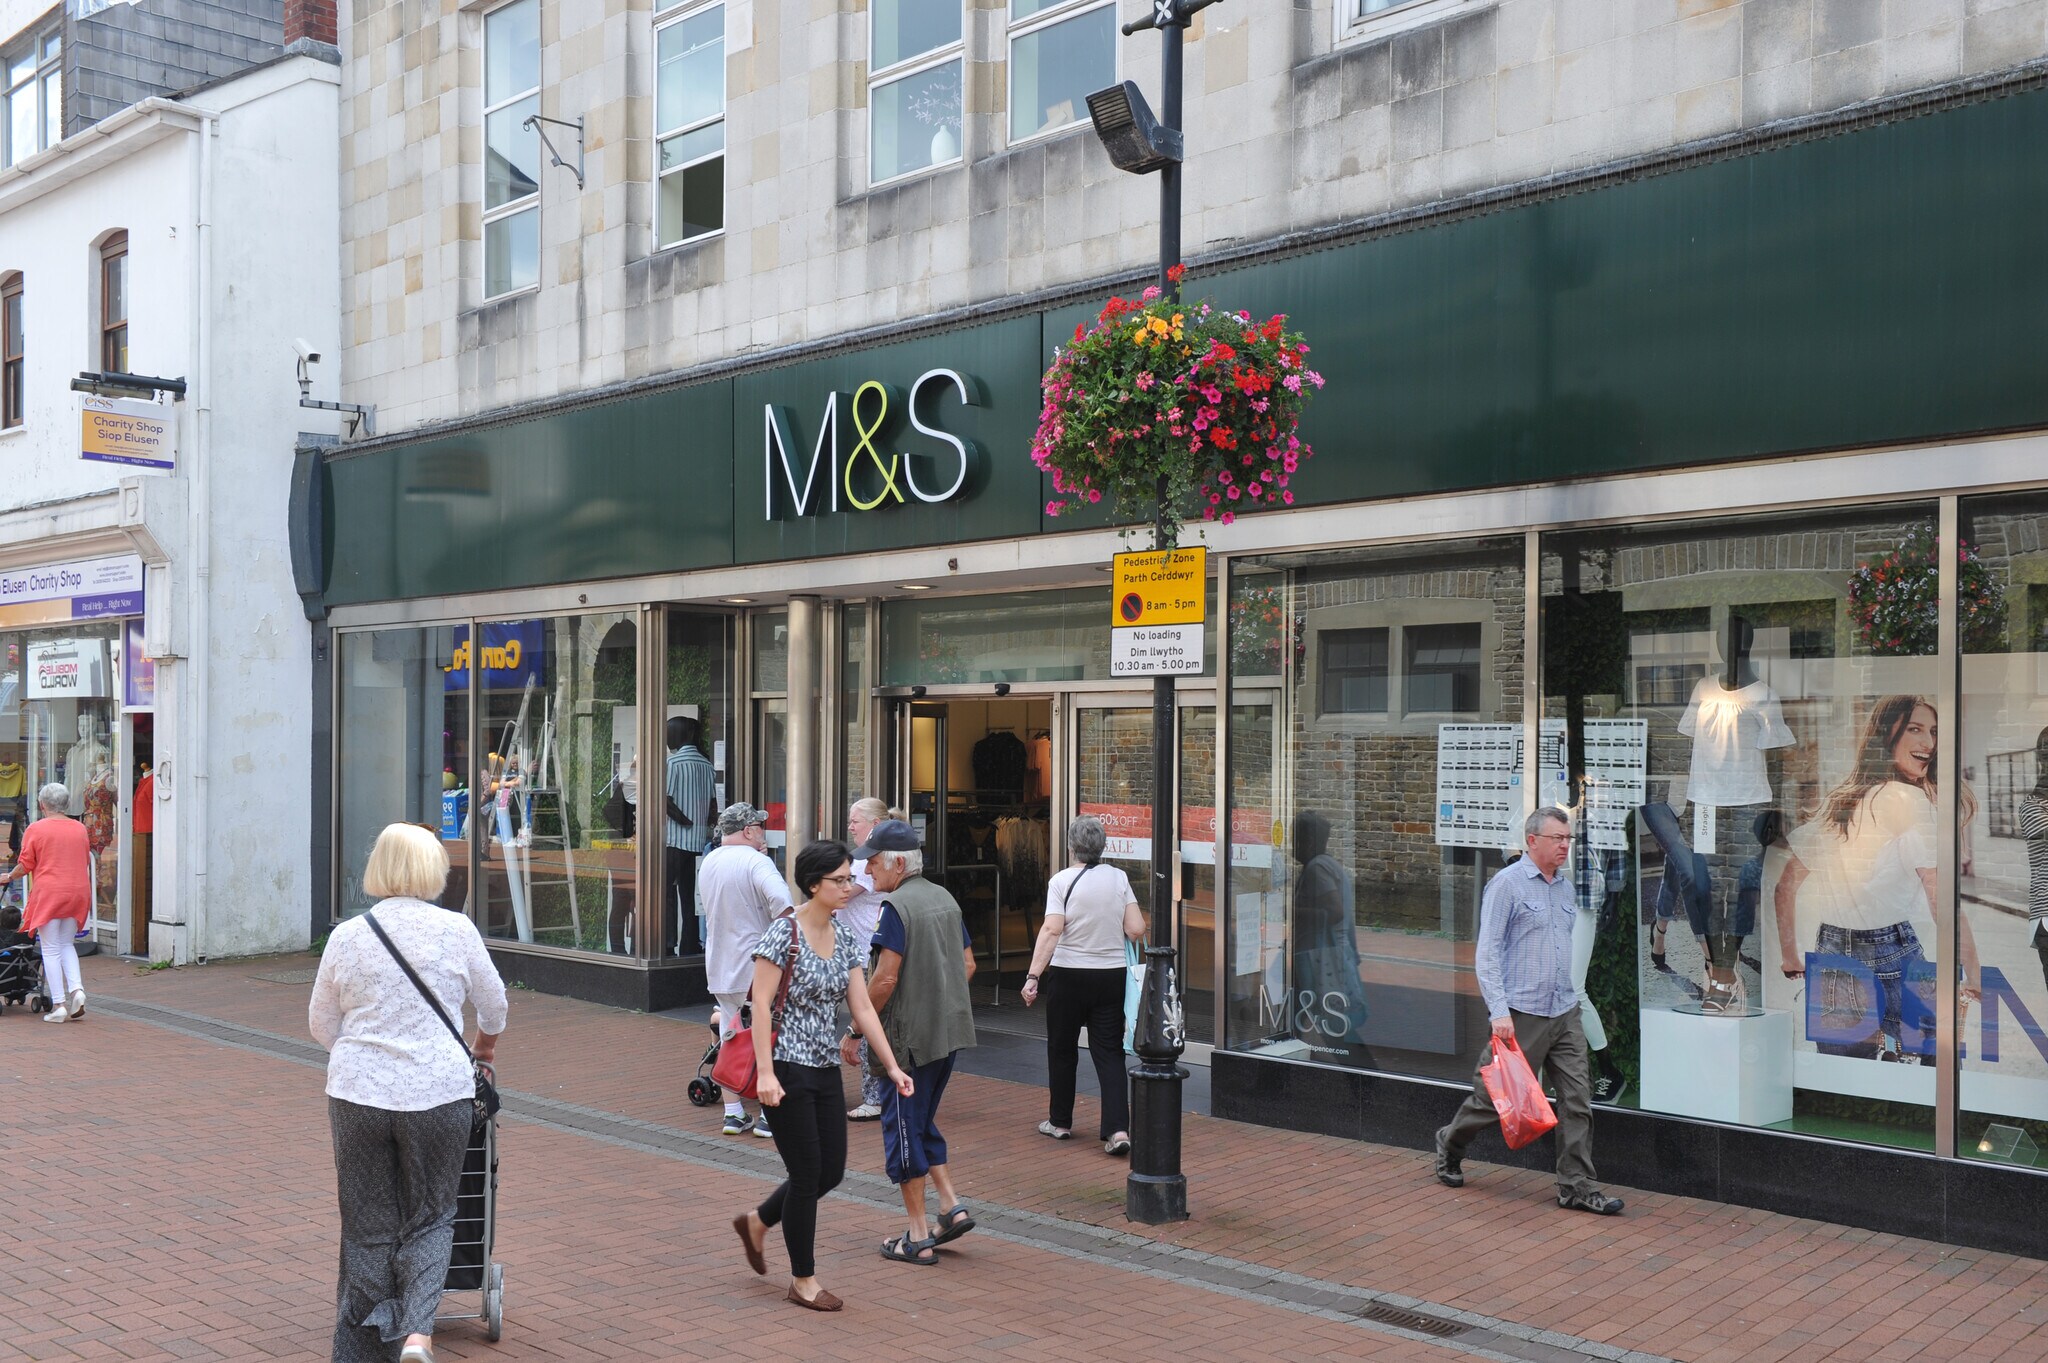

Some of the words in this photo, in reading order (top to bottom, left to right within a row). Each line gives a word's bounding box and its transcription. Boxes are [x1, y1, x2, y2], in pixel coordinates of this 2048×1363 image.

[94, 416, 133, 431] Charity
[136, 421, 163, 435] Shop
[98, 429, 122, 442] Siop
[124, 432, 159, 445] Elusen
[765, 368, 968, 521] M&S
[1173, 553, 1195, 563] Zone
[2, 579, 27, 595] Elusen
[29, 574, 59, 592] Charity
[60, 570, 82, 589] Shop
[1123, 573, 1148, 583] Parth
[1150, 570, 1194, 582] Cerddwyr
[82, 603, 93, 611] Real
[92, 601, 103, 611] Help
[108, 600, 121, 610] Right
[120, 599, 132, 607] Now
[1146, 601, 1152, 610] 8
[1154, 602, 1167, 610] am
[1174, 599, 1180, 609] 5
[1182, 600, 1196, 610] pm
[1133, 631, 1146, 641] No
[1148, 630, 1182, 641] loading
[1130, 647, 1147, 657] Dim
[1150, 646, 1184, 657] llwytho
[1114, 661, 1140, 671] 10.30
[1141, 662, 1155, 670] am
[1161, 660, 1184, 669] 5.00
[1185, 660, 1200, 670] pm
[1259, 984, 1349, 1038] M&S
